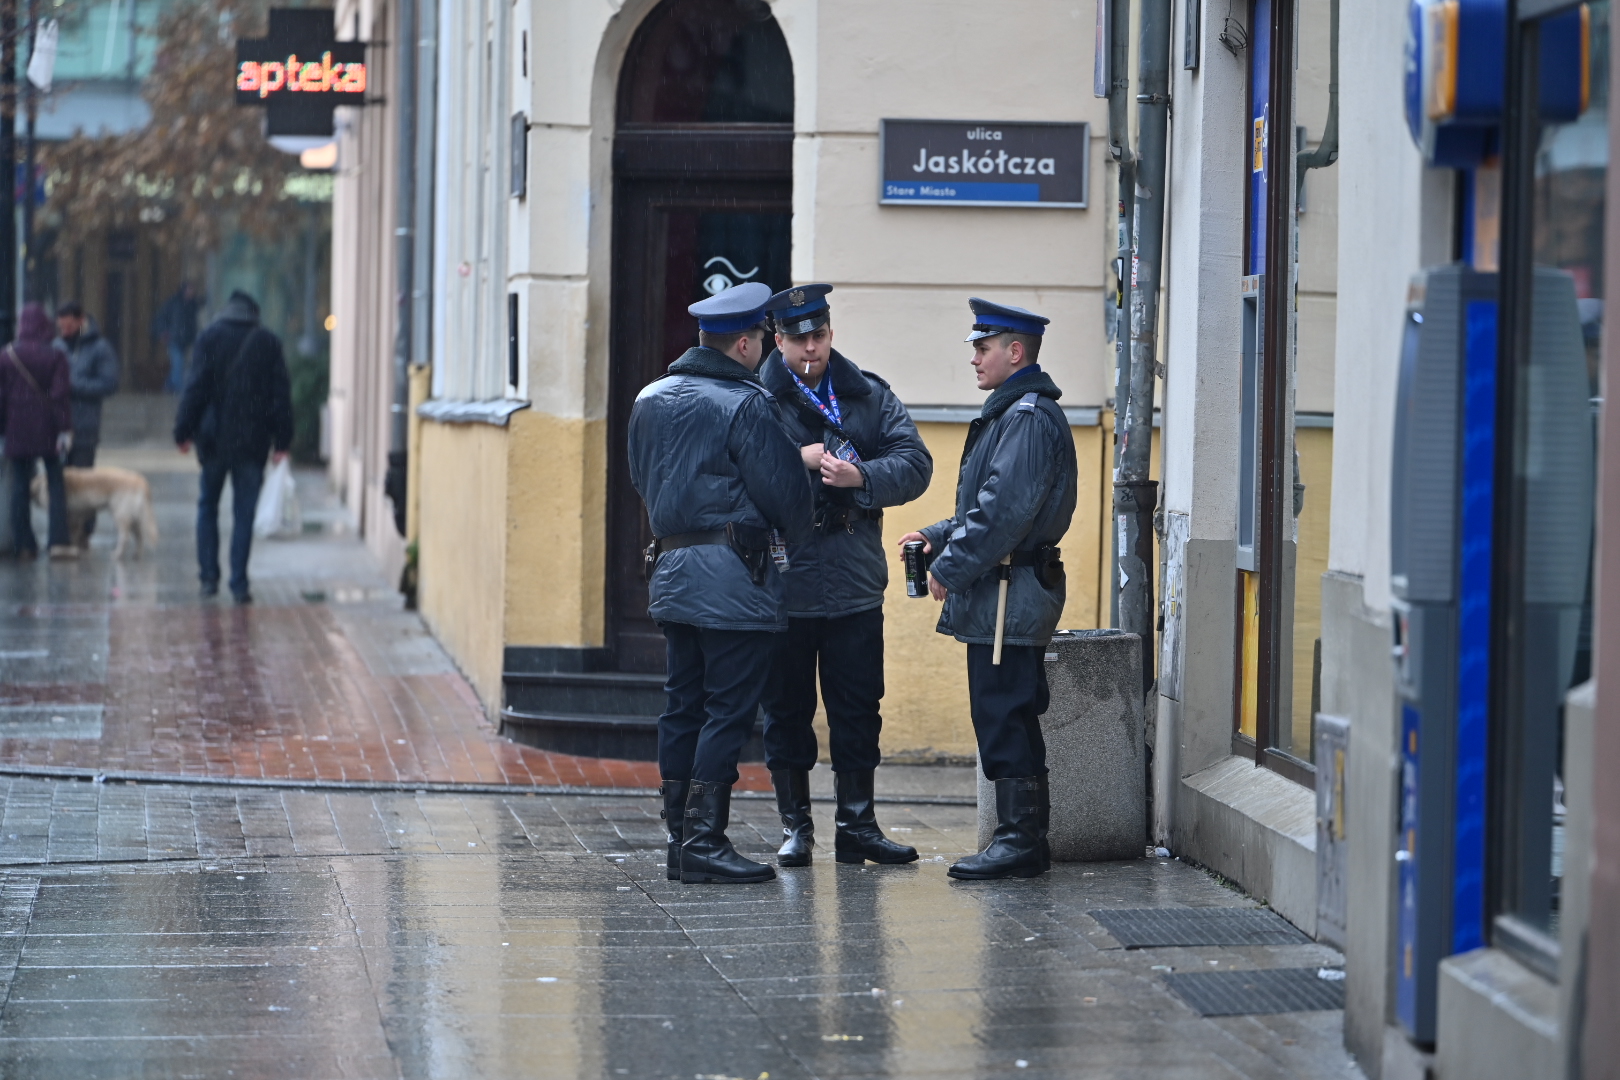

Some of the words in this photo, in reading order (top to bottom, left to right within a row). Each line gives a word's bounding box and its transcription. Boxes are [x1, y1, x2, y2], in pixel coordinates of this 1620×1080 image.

[237, 50, 366, 98] apteka
[966, 127, 1003, 141] ulica
[912, 148, 1056, 175] Jaskółcza
[886, 185, 915, 196] Stare
[919, 186, 956, 197] Miasto
